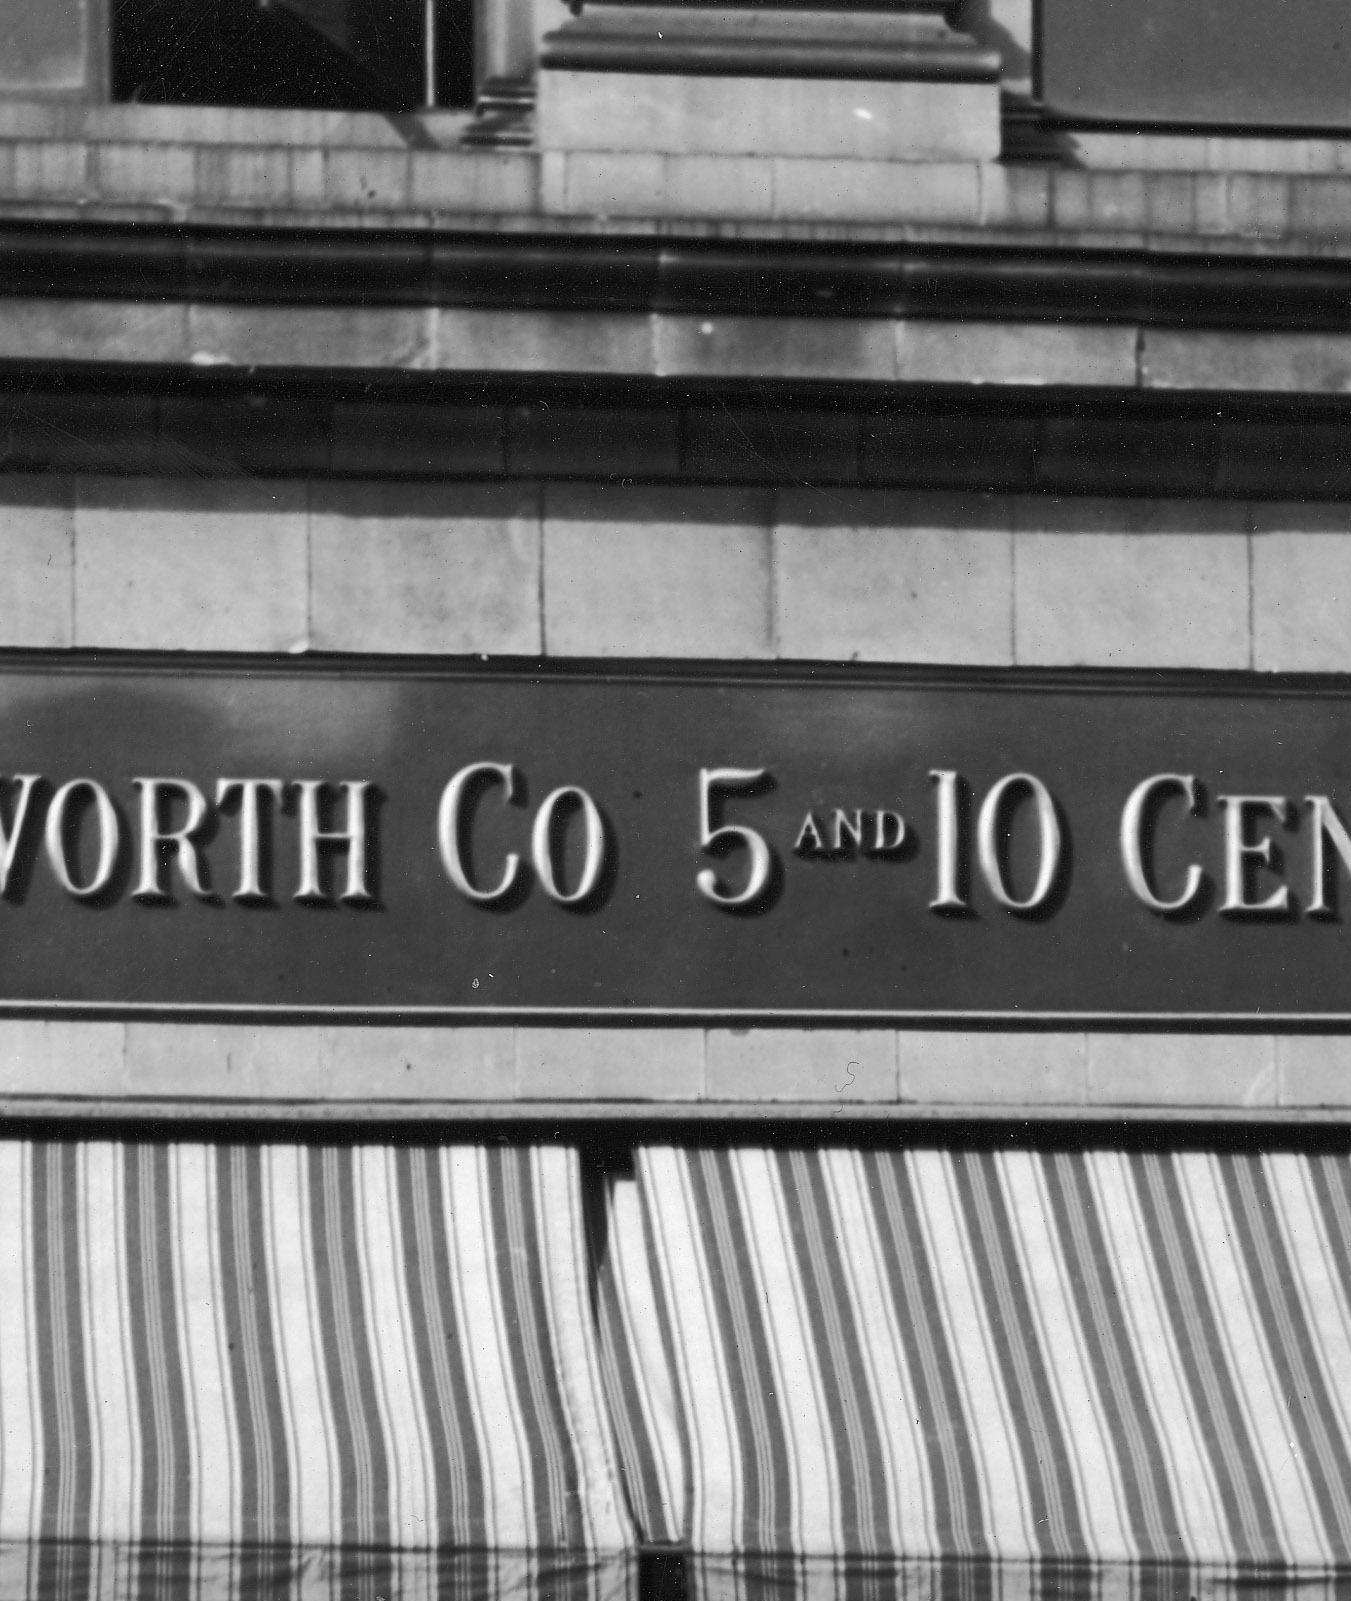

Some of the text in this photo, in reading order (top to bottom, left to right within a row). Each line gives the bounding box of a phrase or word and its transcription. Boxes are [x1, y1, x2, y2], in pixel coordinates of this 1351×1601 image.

[697, 768, 768, 902] 5
[795, 809, 904, 848] AND
[930, 770, 1059, 907] 10
